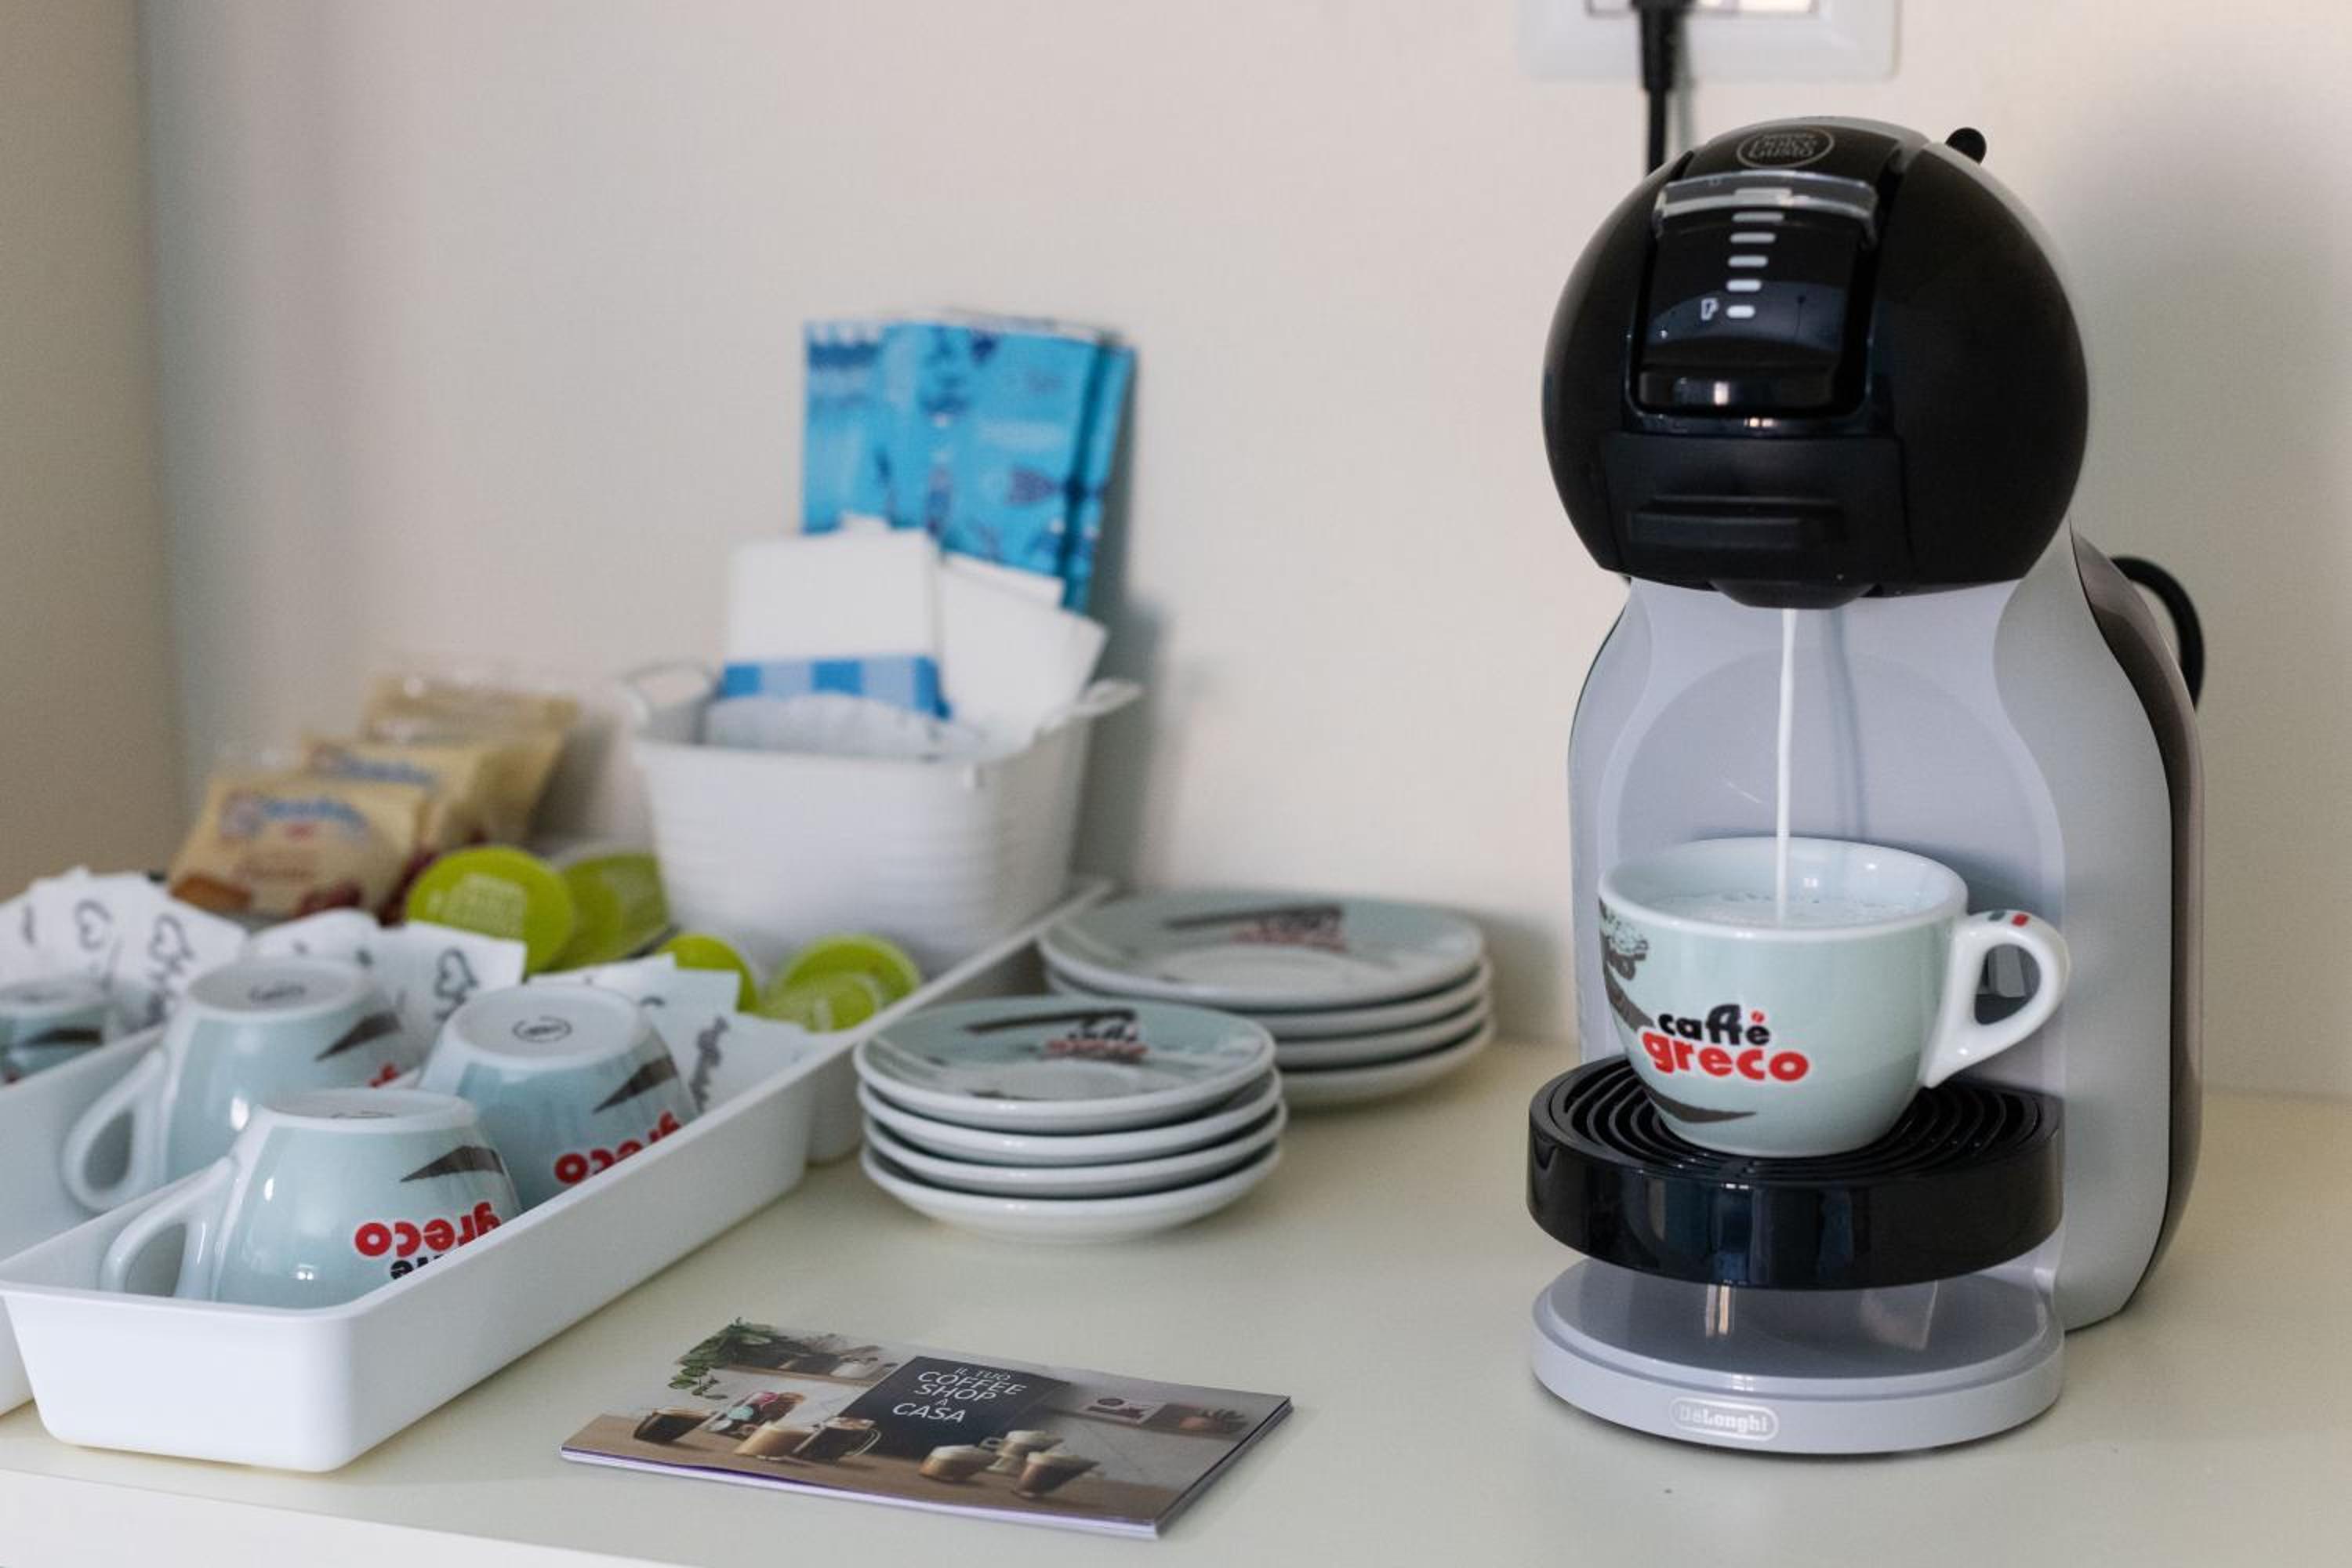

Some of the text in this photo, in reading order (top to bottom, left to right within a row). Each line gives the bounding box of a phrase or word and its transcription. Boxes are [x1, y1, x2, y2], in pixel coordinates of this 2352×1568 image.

[1658, 1004, 1769, 1046] caffè
[1642, 1031, 1809, 1081] greco
[914, 1384, 996, 1401] SHOP
[918, 1371, 1027, 1395] COFFEE
[892, 1403, 966, 1423] CASA
